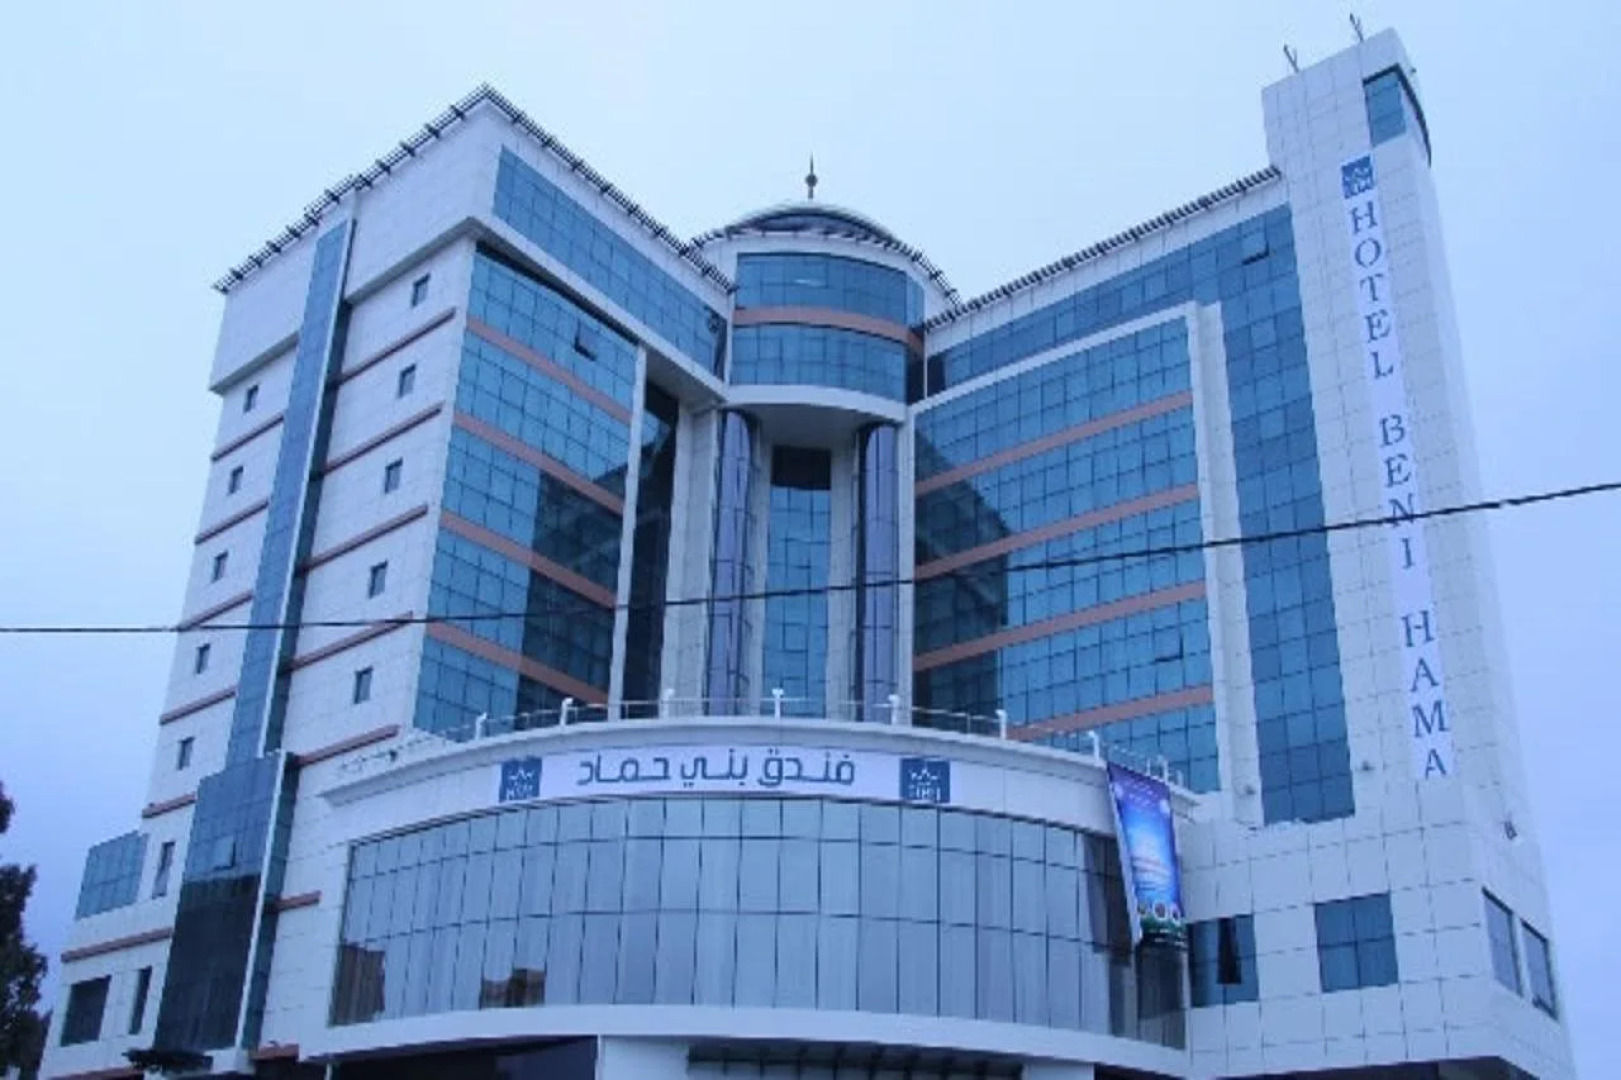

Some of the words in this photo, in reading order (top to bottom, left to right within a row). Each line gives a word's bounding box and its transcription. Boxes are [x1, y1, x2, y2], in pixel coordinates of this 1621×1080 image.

[1350, 201, 1394, 379] HOTEL
[1380, 414, 1415, 569] BENI
[1402, 610, 1449, 780] HAMA
[577, 753, 670, 786] حماد
[680, 748, 748, 788] بني
[758, 748, 856, 787] فندق
